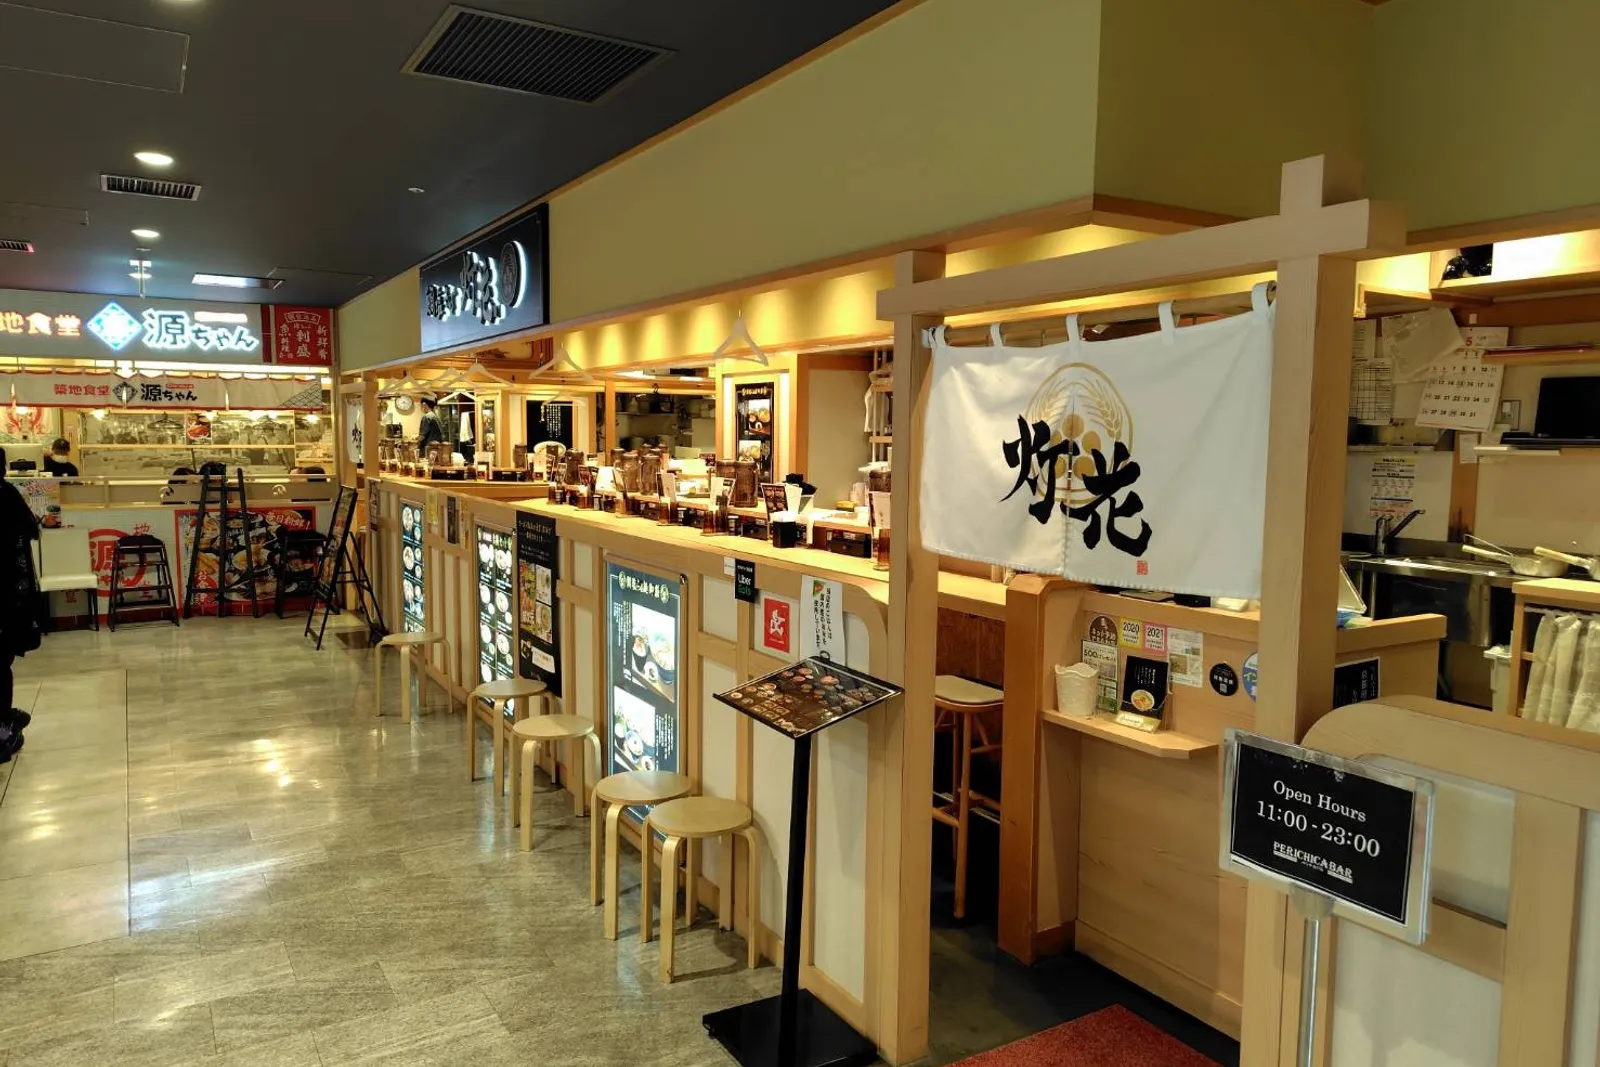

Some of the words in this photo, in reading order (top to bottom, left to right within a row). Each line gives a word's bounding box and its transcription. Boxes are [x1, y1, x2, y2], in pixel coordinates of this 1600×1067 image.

[143, 309, 257, 351] 源ちゃん
[54, 384, 110, 396] 築地食堂
[140, 383, 198, 402] 源ちゃん
[998, 414, 1152, 558] 灯花
[737, 573, 752, 586] Uber
[1123, 621, 1140, 634] 2020
[1147, 627, 1164, 638] 2021
[1273, 780, 1312, 806] Open
[1318, 793, 1367, 823] Hours
